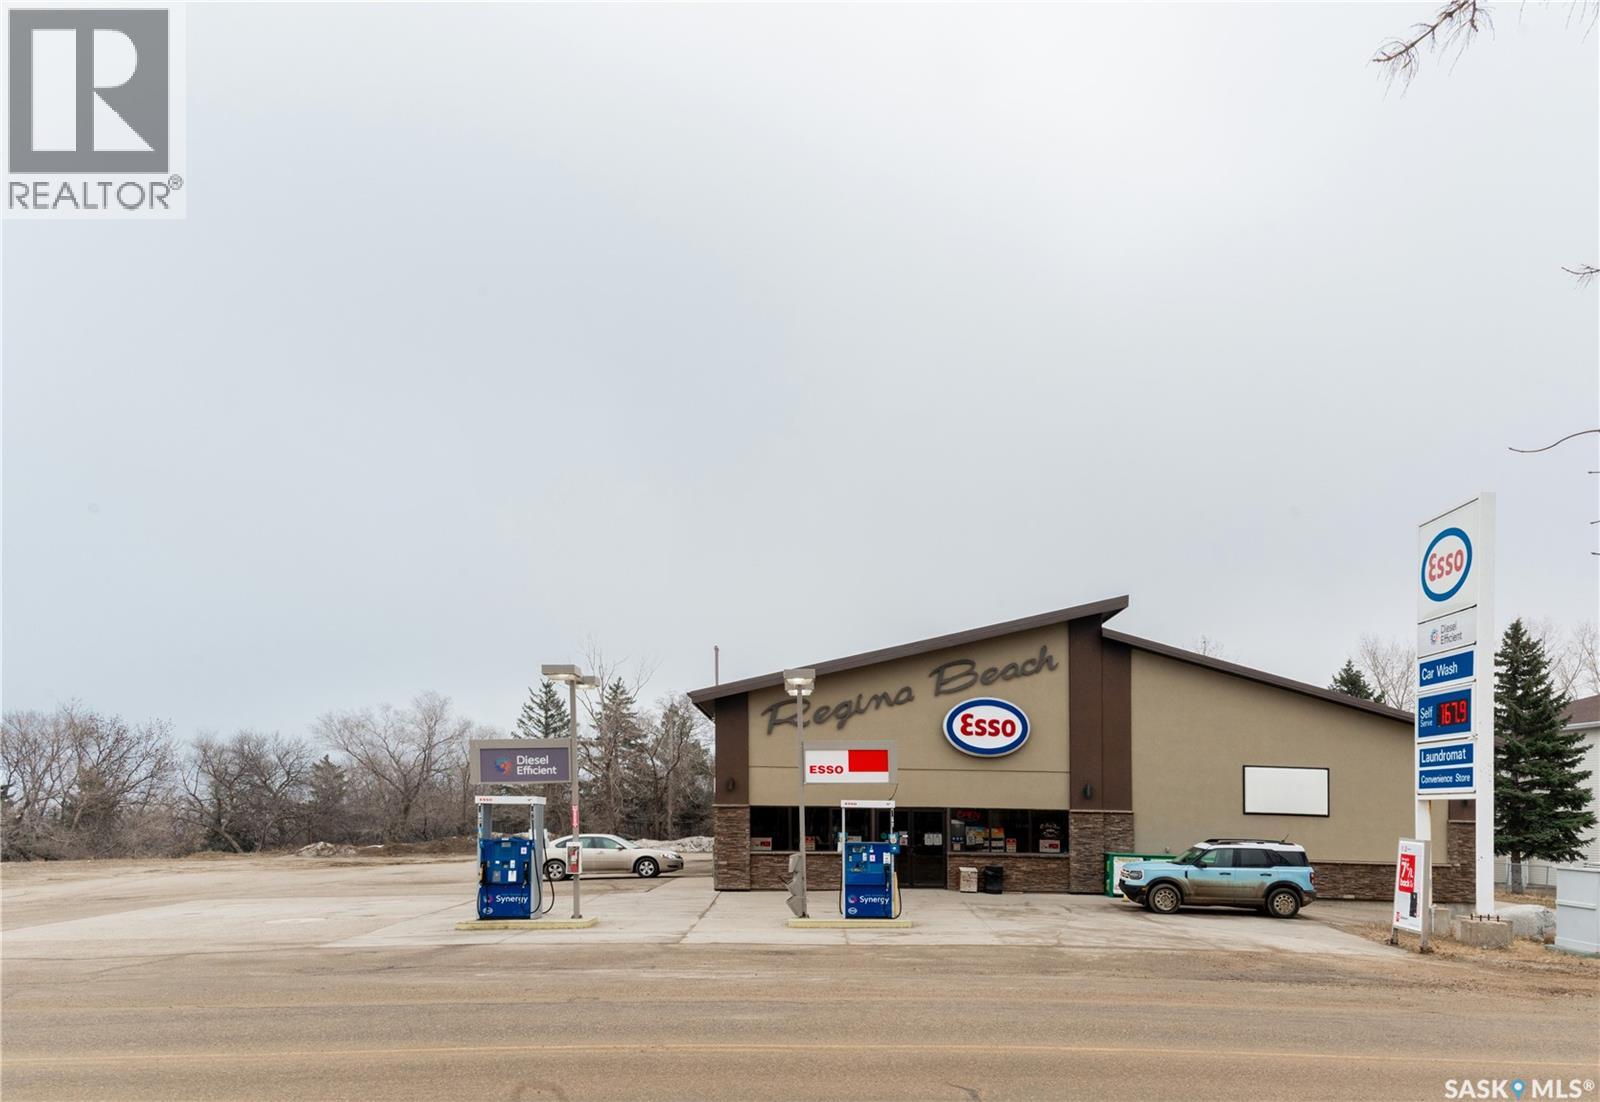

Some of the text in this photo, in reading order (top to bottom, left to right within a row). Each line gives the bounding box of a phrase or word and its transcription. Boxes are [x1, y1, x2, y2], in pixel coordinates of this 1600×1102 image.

[1440, 623, 1457, 634] Diesel
[1440, 632, 1463, 645] Efficient
[1421, 662, 1458, 681] Car Wash
[761, 645, 1059, 736] Regina Beach
[1420, 706, 1433, 720] Self
[1420, 719, 1433, 728] Serve
[516, 755, 549, 765] Diesel
[1421, 748, 1467, 763] Laundromat
[516, 766, 558, 775] Efficient
[809, 765, 844, 775] ESSO
[1420, 773, 1471, 784] Convenience Store
[495, 895, 528, 905] Synergy
[859, 895, 890, 905] Synergy
